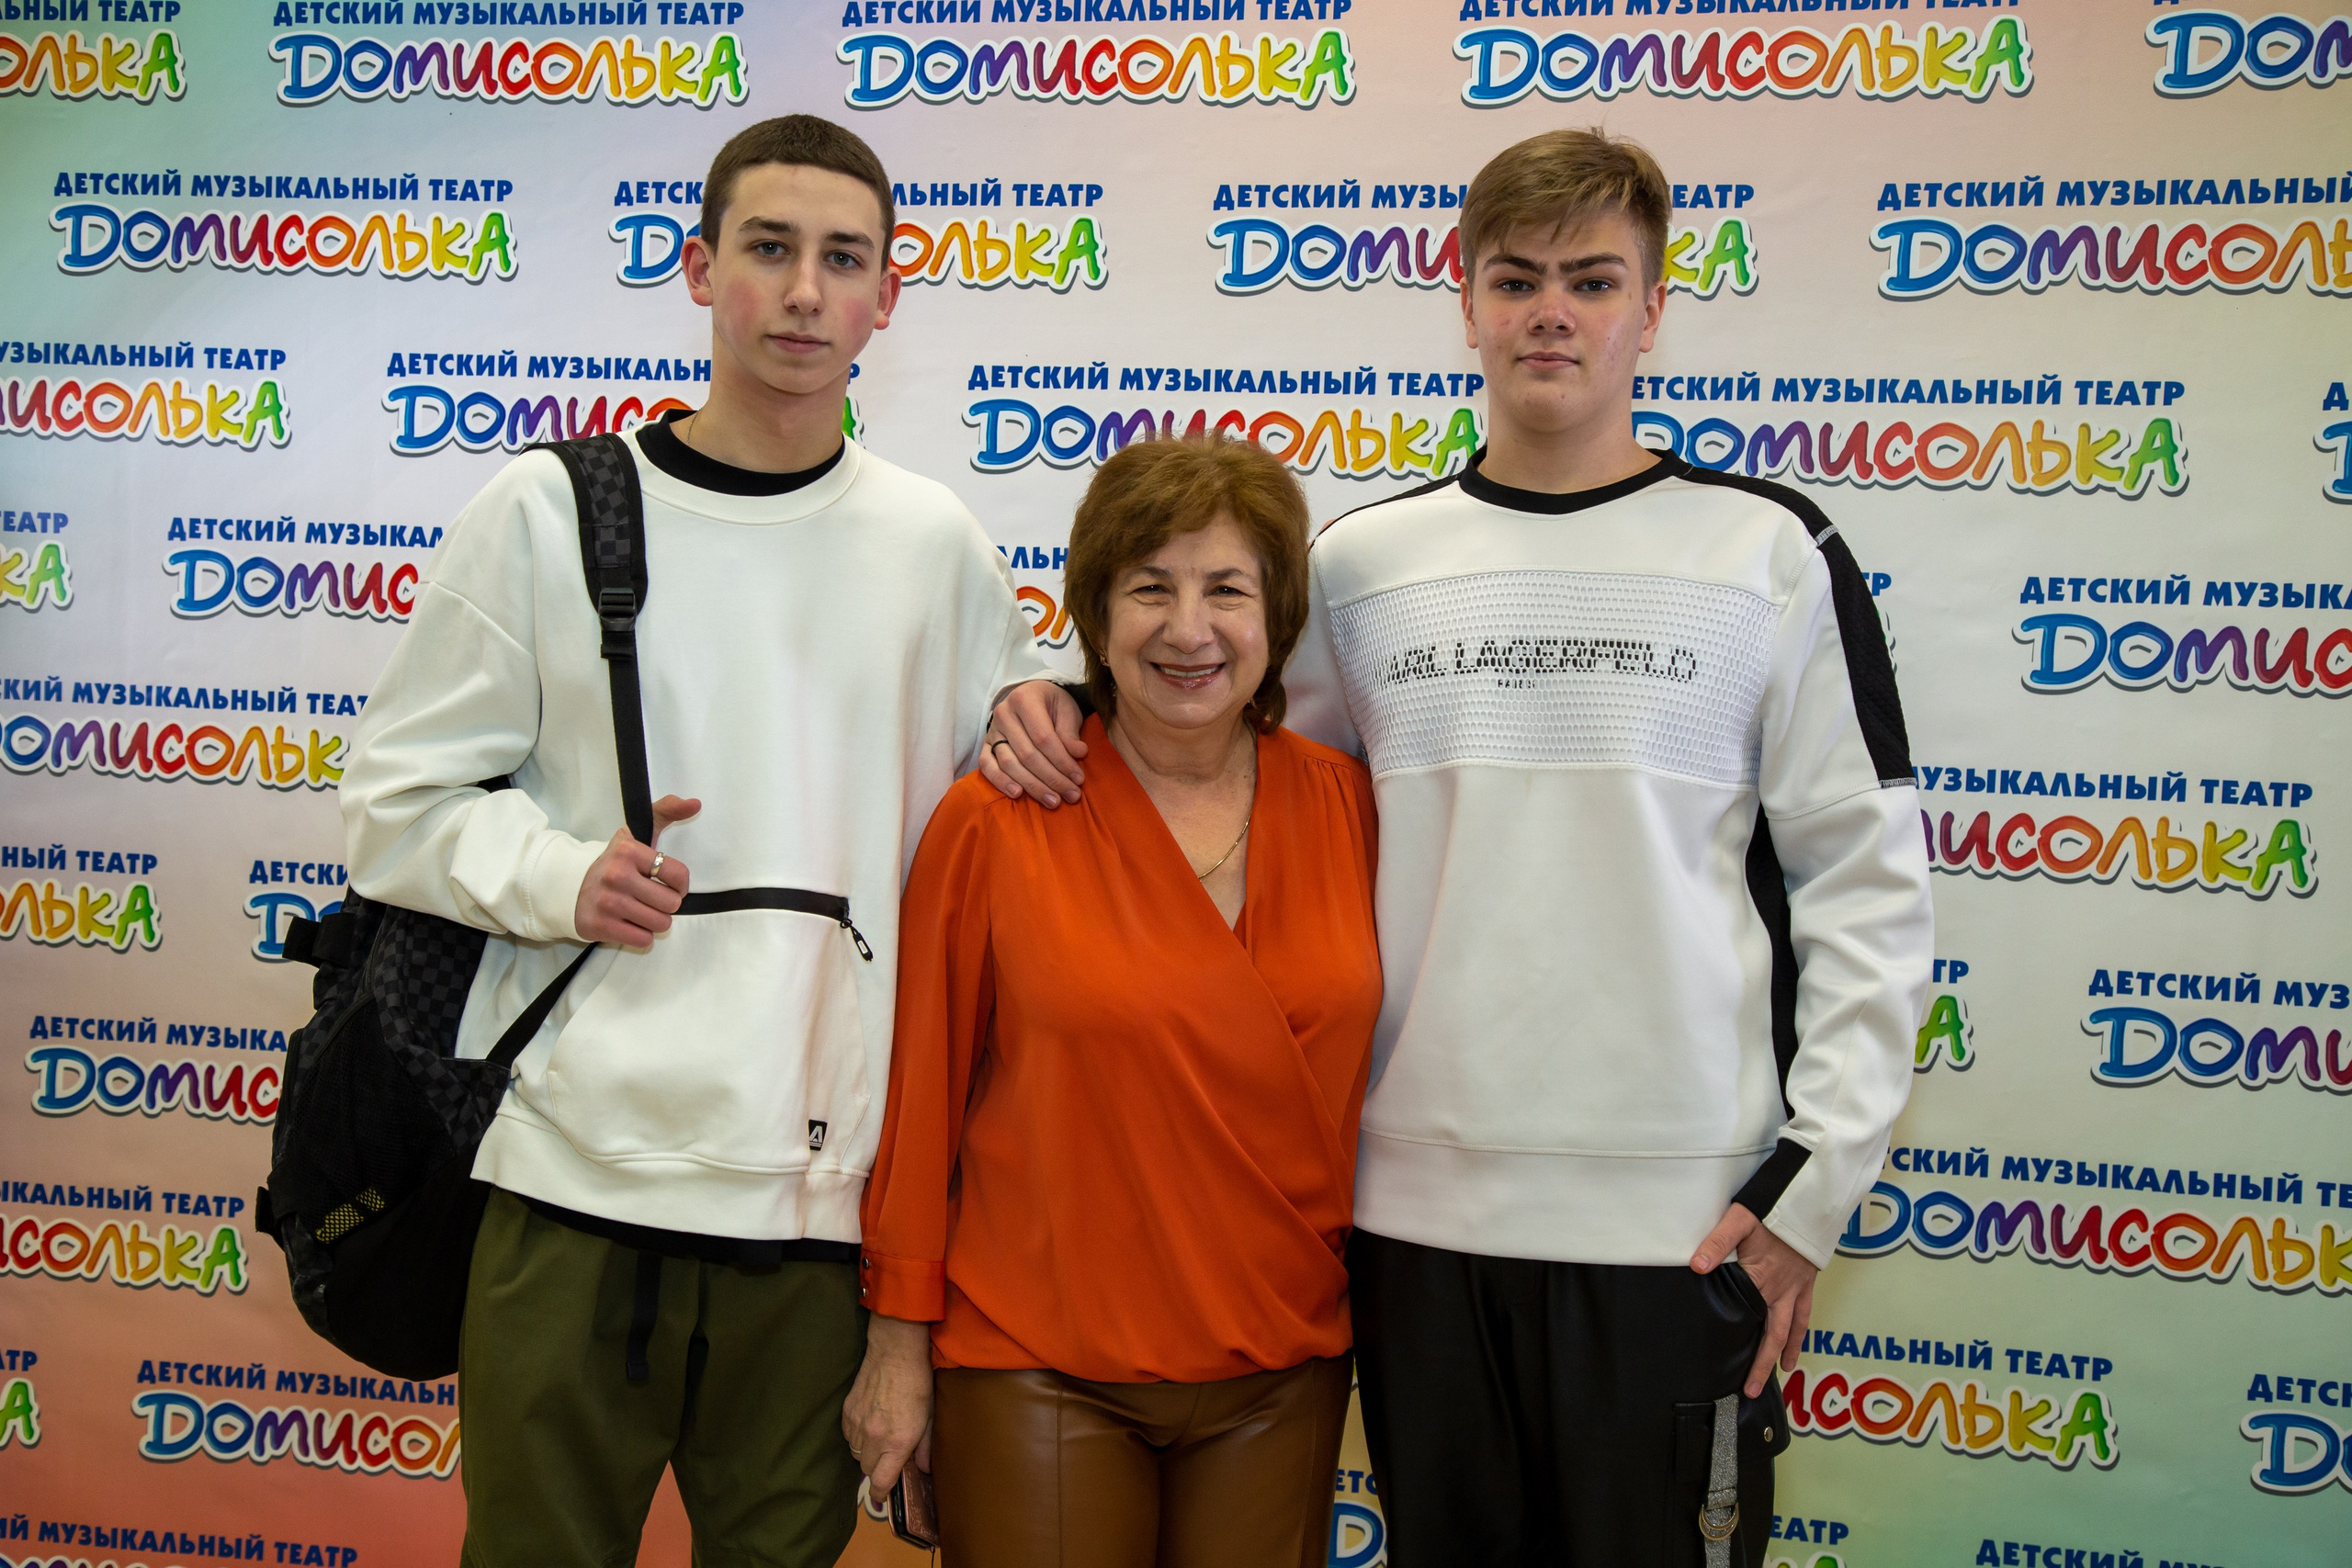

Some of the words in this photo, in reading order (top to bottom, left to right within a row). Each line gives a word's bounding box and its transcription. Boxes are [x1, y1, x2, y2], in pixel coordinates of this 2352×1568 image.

[98, 0, 181, 23] ТЕАТР
[657, 2, 744, 26] ТЕАТР
[1255, 0, 1352, 21] ТЕАТР
[54, 169, 181, 197] ДЕТСКИЙ
[190, 173, 419, 201] МУЗЫКАЛЬНЫЙ
[428, 178, 514, 202] ТЕАТР
[1012, 183, 1103, 208] ТЕАТР
[1213, 178, 1361, 211] ДЕТСКИЙ
[1670, 184, 1755, 209] ЕАТР
[1877, 175, 2044, 211] ДЕТСКИЙ
[203, 347, 287, 371] ТЕАТР
[387, 349, 517, 378] ДЕТСКИЙ
[967, 361, 1109, 391] ДЕТСКИЙ
[1119, 366, 1377, 396] МУЗЫКАЛЬНЫЙ
[1388, 372, 1485, 398] ТЕАТР
[1771, 373, 2062, 405] МУЗЫКАЛЬНЫЙ
[2074, 380, 2186, 406] ТЕАТР
[0, 377, 285, 444] ИСОЛЬКА
[0, 510, 69, 534] ЕАТР
[167, 515, 296, 543] ДЕТСКИЙ
[2020, 573, 2191, 605] ДЕТСКИЙ
[72, 682, 297, 714] МУЗЫКАЛЬНЫЙ
[2199, 778, 2313, 808] ТЕАТР
[75, 850, 158, 875] ТЕАТР
[2088, 968, 2261, 1004] ДЕТСКИЙ
[30, 1015, 157, 1043] ДЕТСКИЙ
[2001, 1156, 2303, 1204] МУЗЫКАЛЬНЫЙ
[162, 1192, 244, 1218] ТЕАТР
[137, 1360, 266, 1389] ДЕТСКИЙ
[2005, 1348, 2113, 1382] ТЕАТР
[39, 1522, 264, 1561] МУЗЫКАЛЬНЫЙ
[275, 1541, 357, 1568] ТЕАТР
